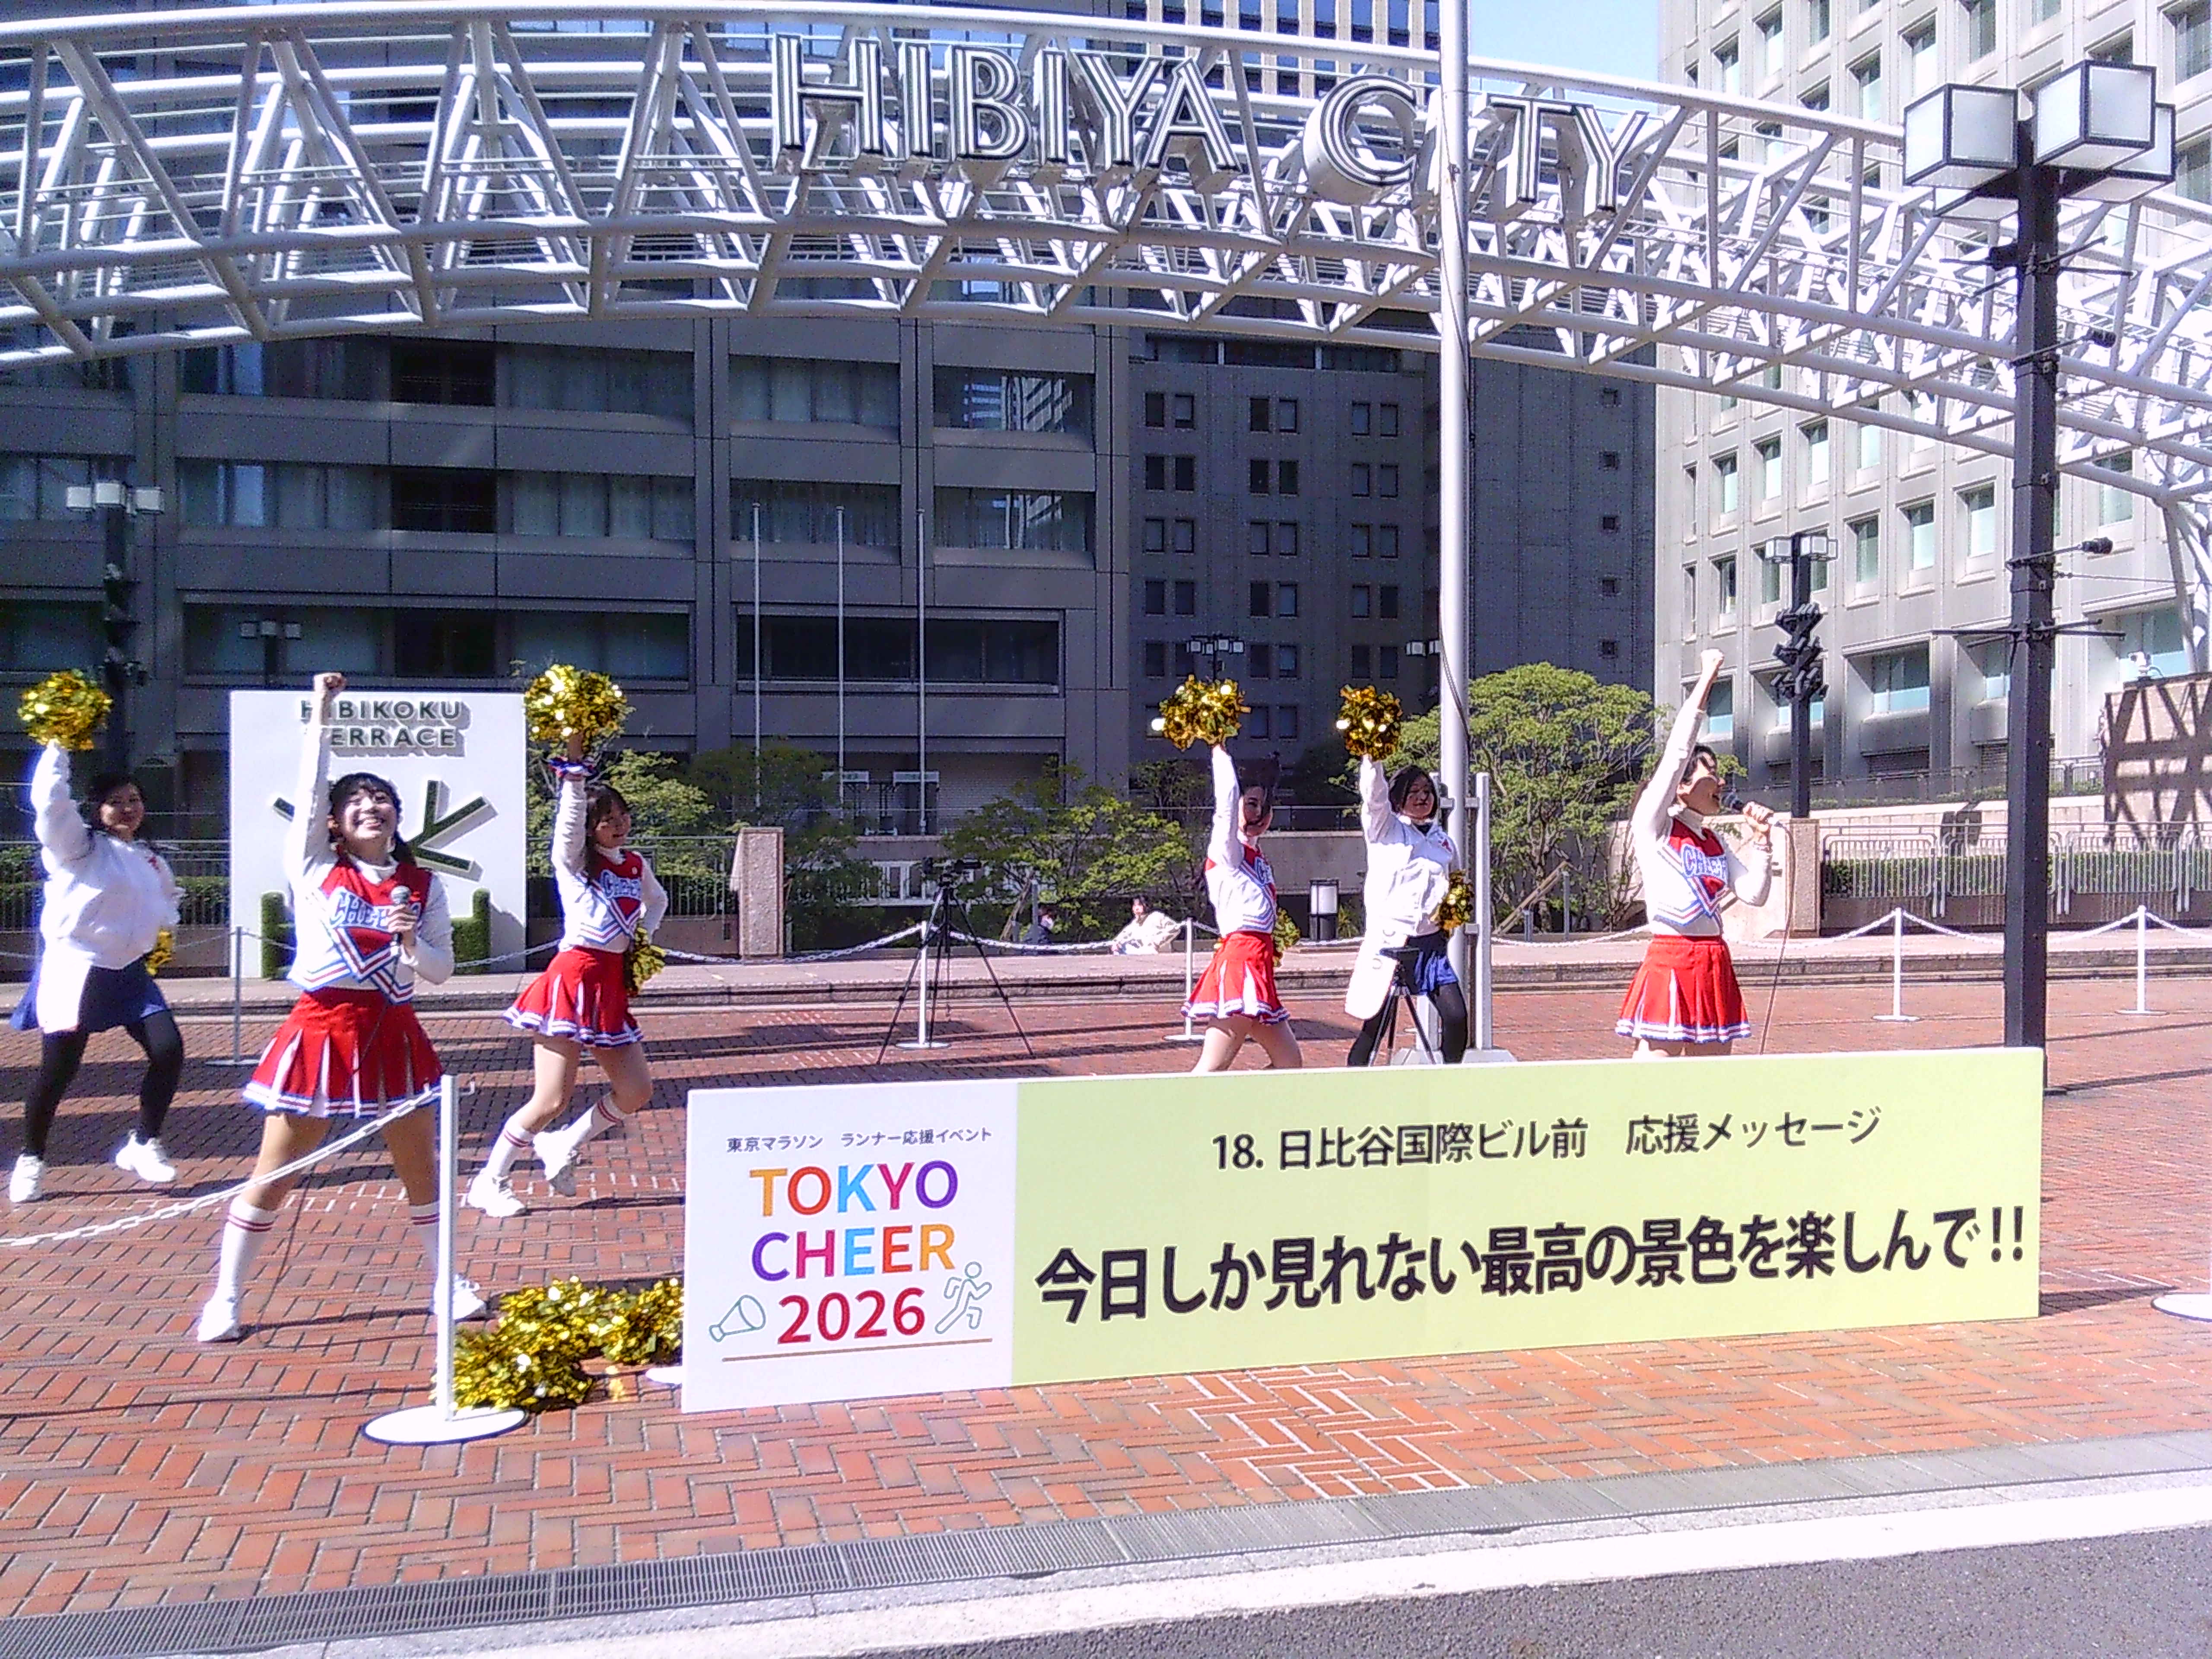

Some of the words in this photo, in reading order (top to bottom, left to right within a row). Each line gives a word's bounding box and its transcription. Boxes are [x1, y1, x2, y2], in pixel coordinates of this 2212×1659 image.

[776, 34, 1241, 173] HIBIYA
[1320, 74, 1650, 212] CTY
[301, 700, 460, 719] HBIKOKU
[327, 728, 457, 746] ERRACE
[727, 1136, 823, 1153] 東京マラソン
[841, 1128, 992, 1147] ランナー応援イベント
[1212, 1133, 1264, 1170] 18.
[1279, 1117, 1589, 1170] 日比谷国際ビル前
[1625, 1106, 1881, 1155] 応援メッセージ
[749, 1160, 958, 1217] TOKYO
[752, 1224, 956, 1282] CHEER
[1035, 1206, 2024, 1324] 今日しか見れない最高の景色を楽しんで!!
[778, 1287, 925, 1344] 2026
